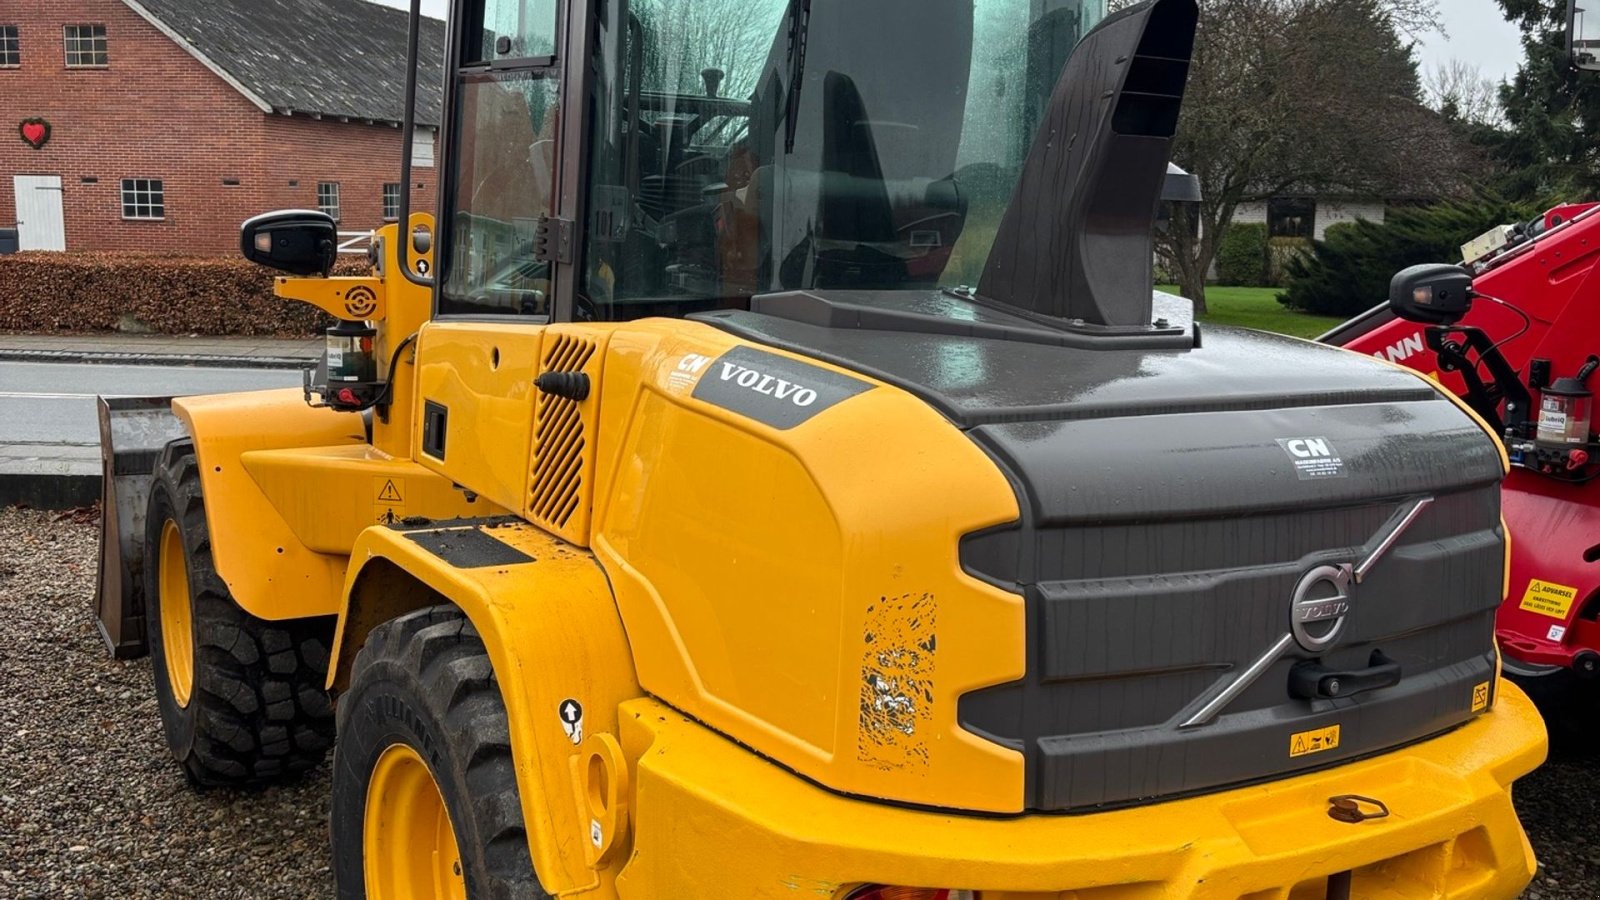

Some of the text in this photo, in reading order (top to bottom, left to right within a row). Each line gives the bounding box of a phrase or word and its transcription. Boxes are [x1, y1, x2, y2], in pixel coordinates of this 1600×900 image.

[677, 353, 711, 373] CN
[719, 361, 818, 407] VOLVO
[1287, 438, 1331, 458] CN
[1296, 602, 1349, 619] VOLVO
